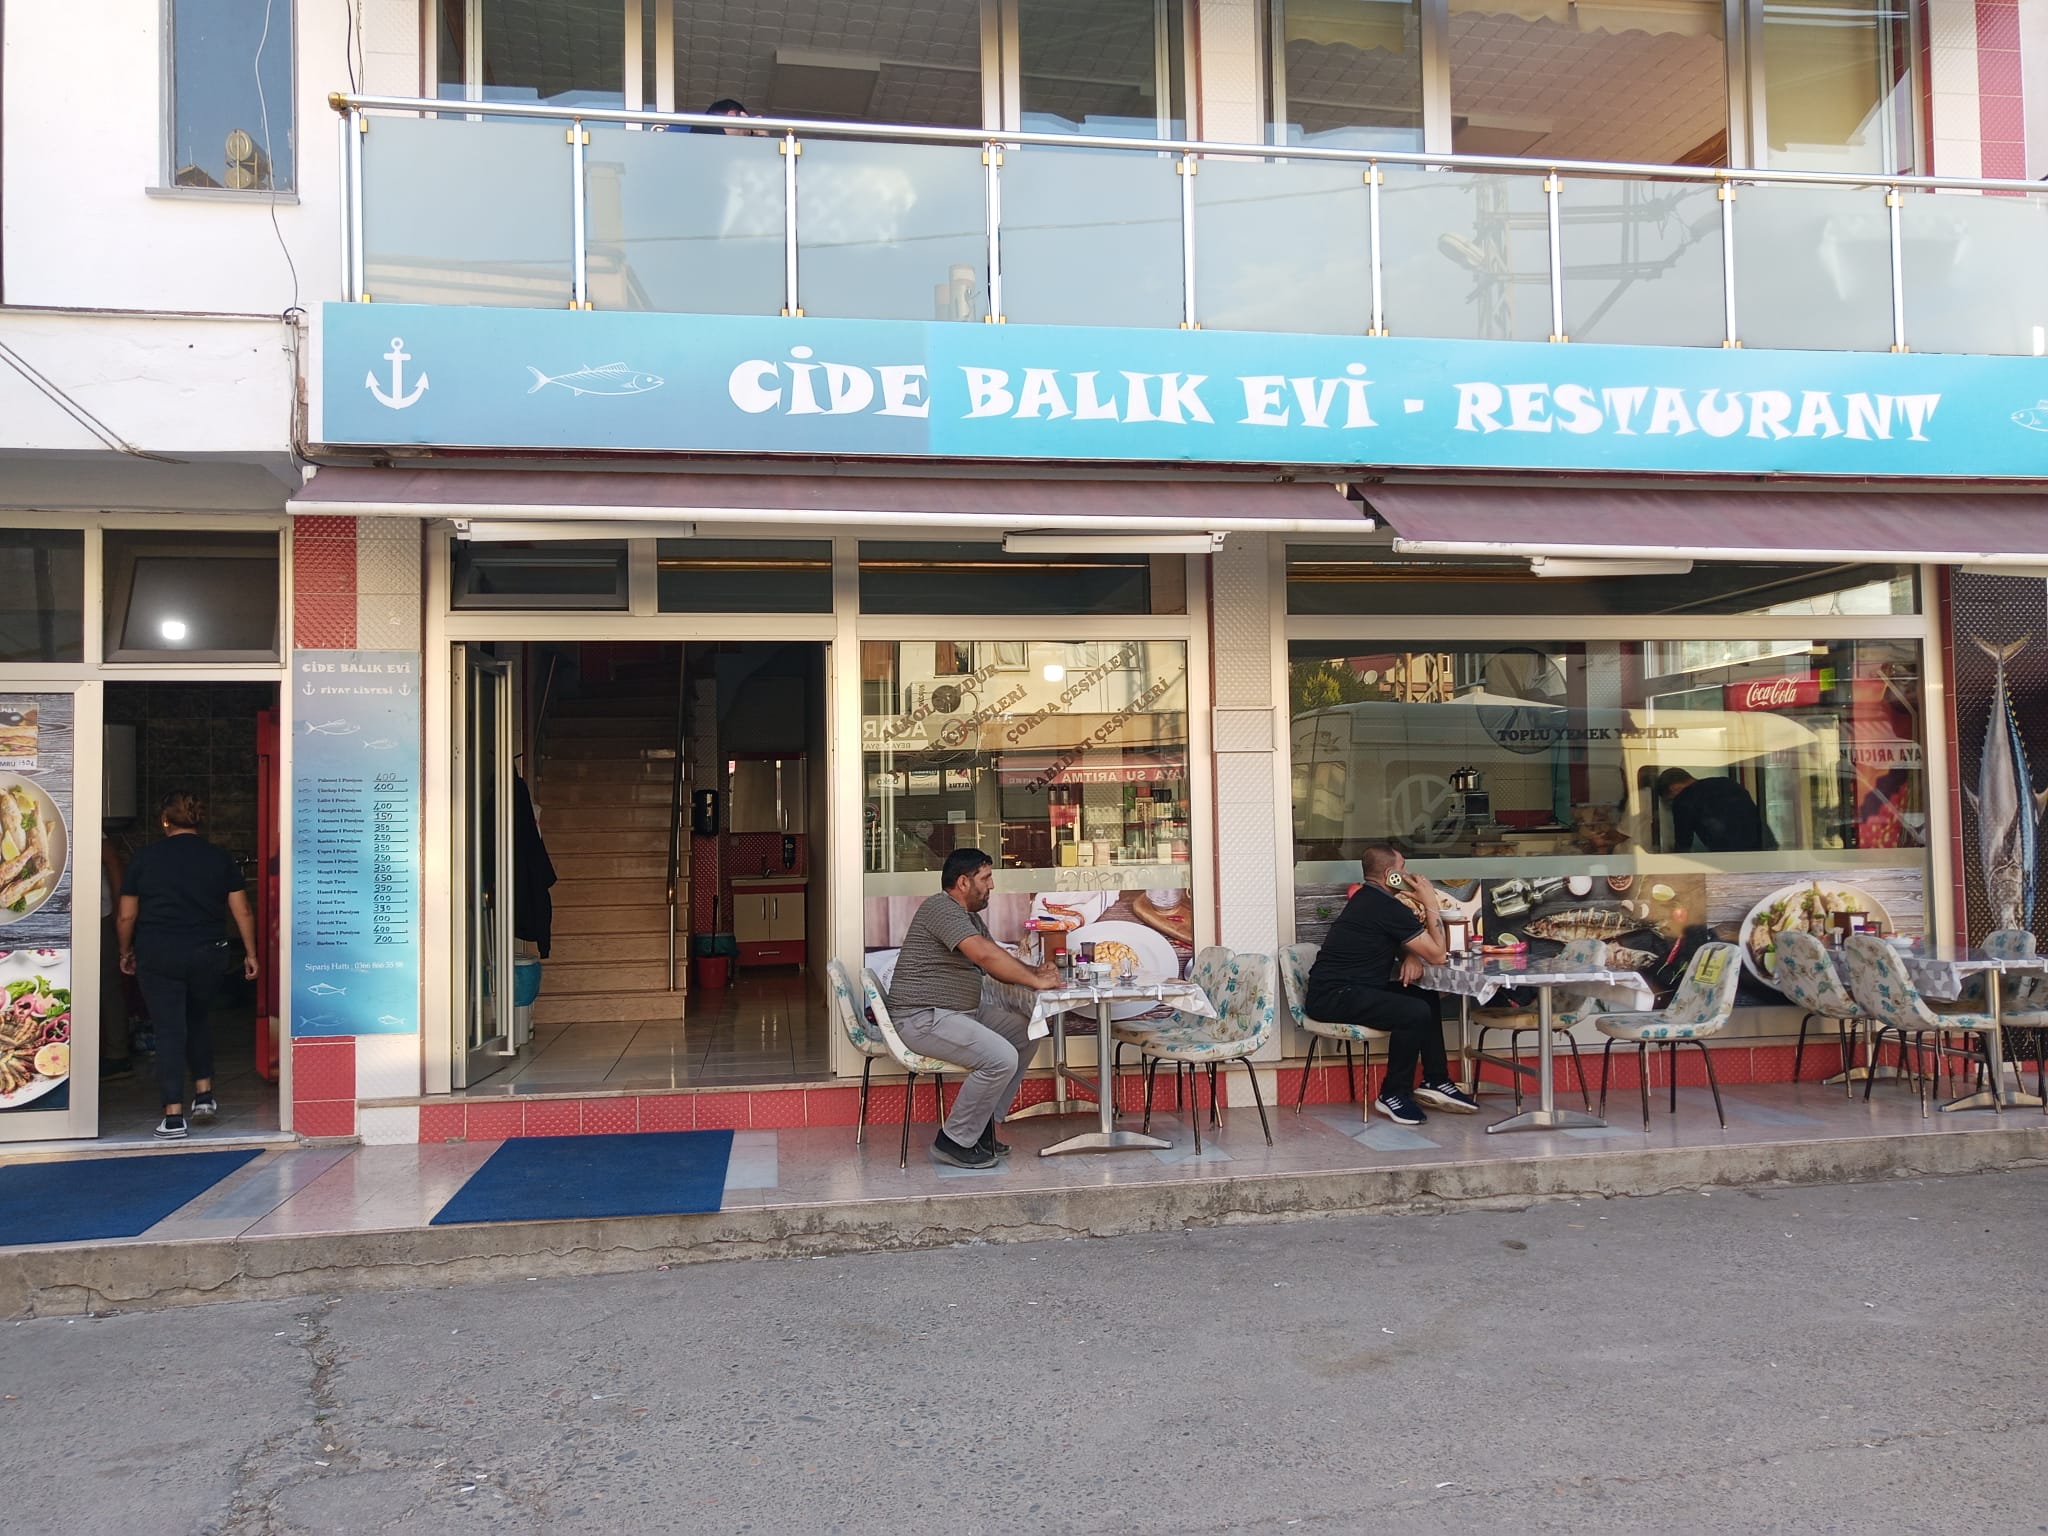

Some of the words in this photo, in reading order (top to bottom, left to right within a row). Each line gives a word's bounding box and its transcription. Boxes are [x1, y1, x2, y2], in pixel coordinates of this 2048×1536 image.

[728, 345, 931, 420] CİDE
[962, 364, 1216, 427] BALIK
[1237, 361, 1380, 430] EVİ
[1453, 380, 1944, 444] RESTAURANT
[302, 661, 336, 673] CİDE
[340, 663, 383, 673] BALIK
[387, 662, 411, 673] EVİ
[1005, 701, 1061, 745] ÇORBA
[1059, 642, 1138, 706] ÇEŞİTLERİ
[1745, 676, 1800, 708] Coca-Cola
[1024, 737, 1094, 795] TABLDOT
[1093, 676, 1171, 742] ÇEŞİTLERİ
[1497, 728, 1551, 742] TOPLU
[1554, 727, 1611, 741] YEMEK
